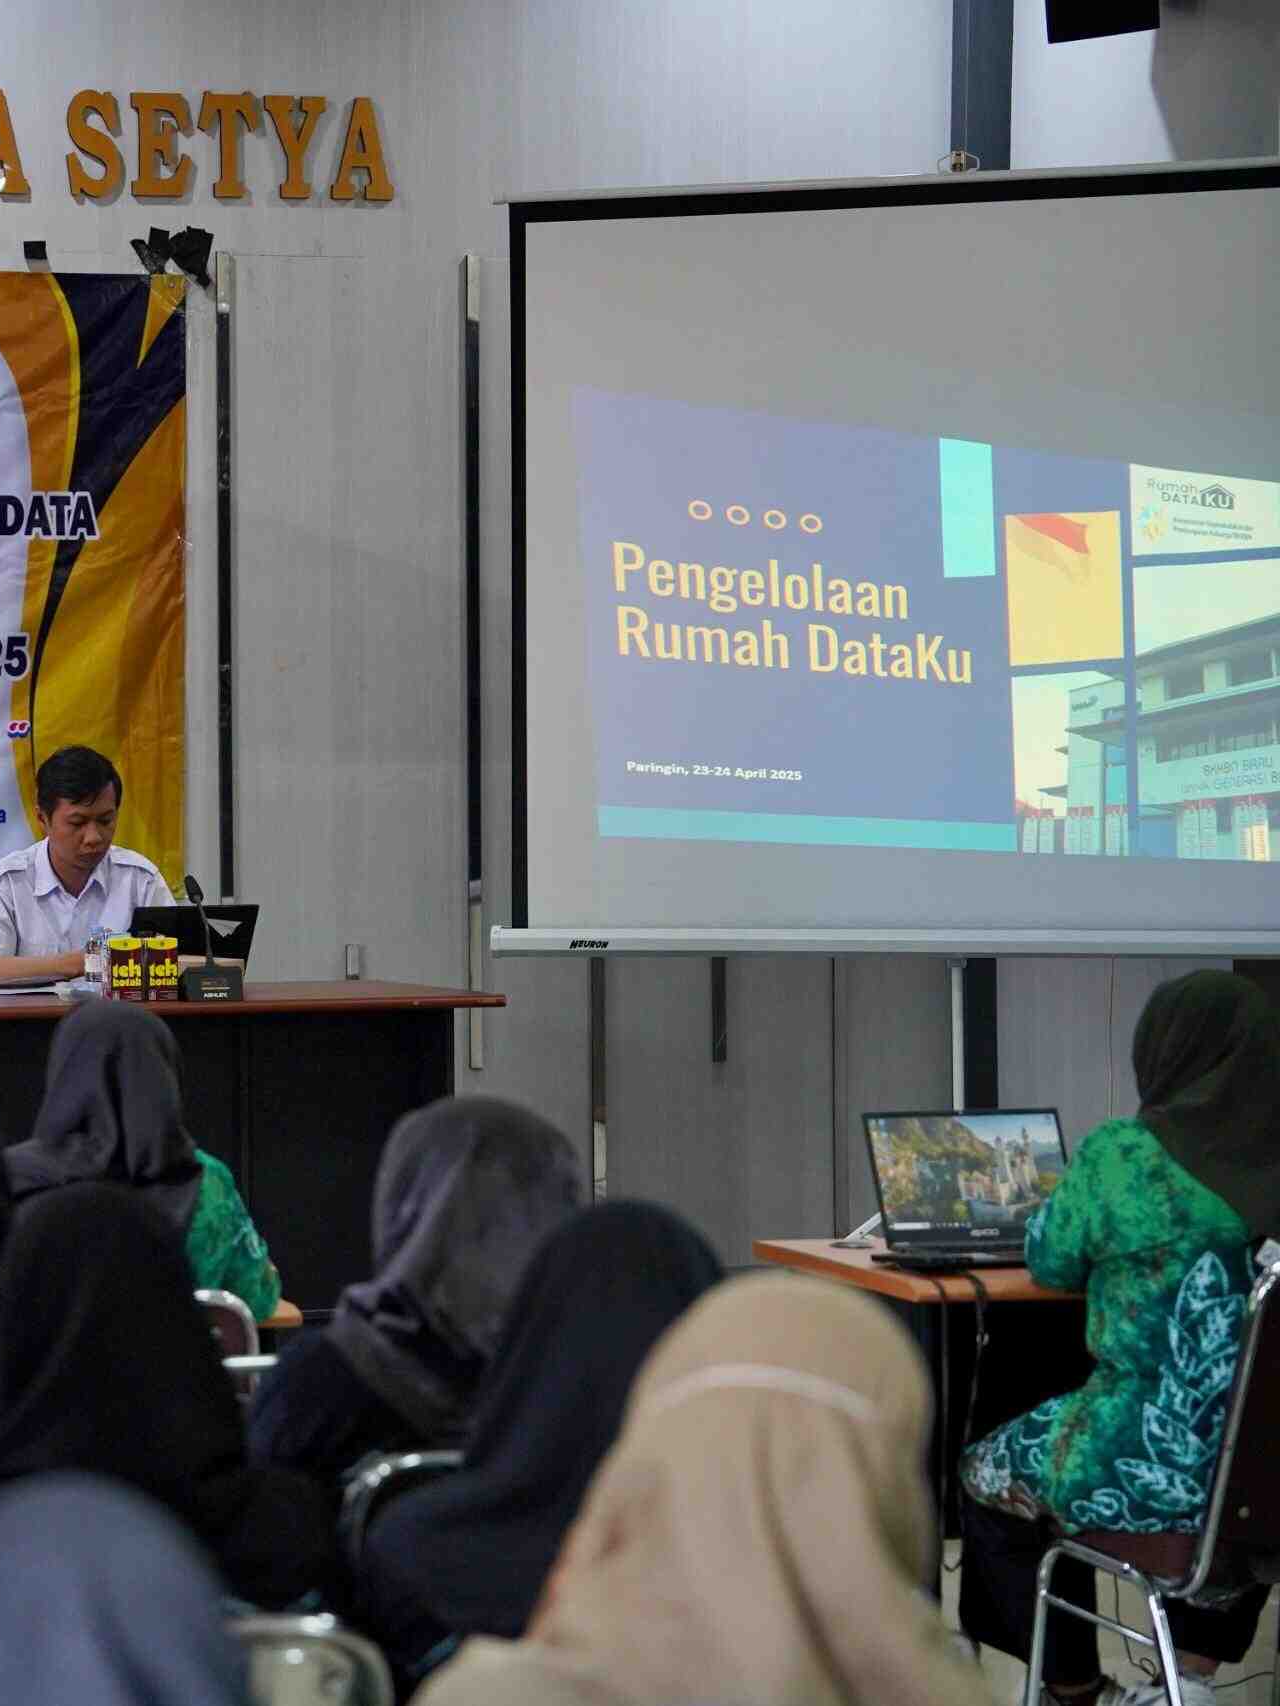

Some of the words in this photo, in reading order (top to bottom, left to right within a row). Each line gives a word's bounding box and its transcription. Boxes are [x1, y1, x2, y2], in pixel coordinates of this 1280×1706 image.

[65, 88, 395, 201] SETYA
[612, 541, 910, 621] Pengelolaan
[616, 604, 791, 670] Rumah
[808, 621, 974, 684] DataKu
[626, 760, 689, 776] Paringin,
[734, 767, 767, 780] April
[769, 769, 803, 781] 2025
[569, 940, 609, 949] NEURON
[112, 958, 141, 977] teh
[149, 958, 178, 976] teh
